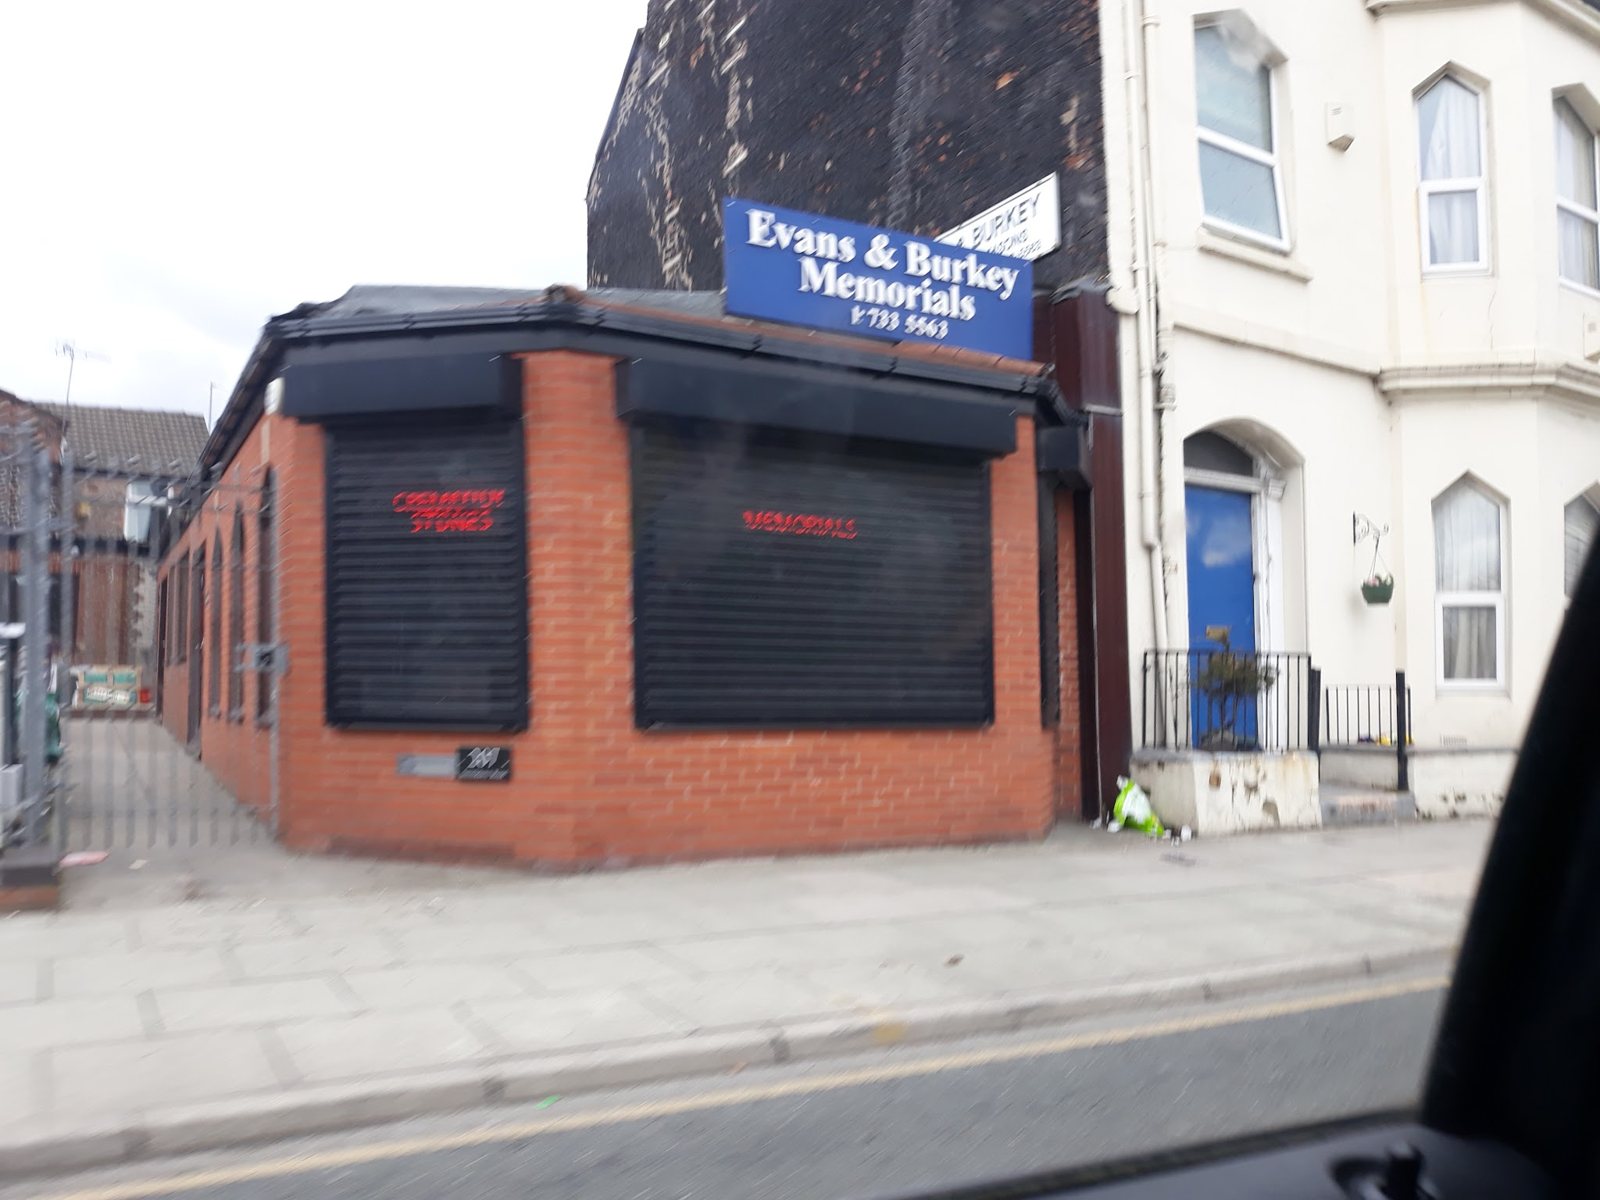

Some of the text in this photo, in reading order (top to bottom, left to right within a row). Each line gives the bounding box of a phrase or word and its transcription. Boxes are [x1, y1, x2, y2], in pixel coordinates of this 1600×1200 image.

[972, 192, 1041, 250] BURKEY
[746, 208, 1021, 301] Evans & Burkey
[798, 257, 976, 322] Memorials
[866, 307, 901, 332] 733
[904, 314, 949, 340] 5563
[410, 509, 494, 533] STONES
[742, 510, 857, 539] MEMORIALS
